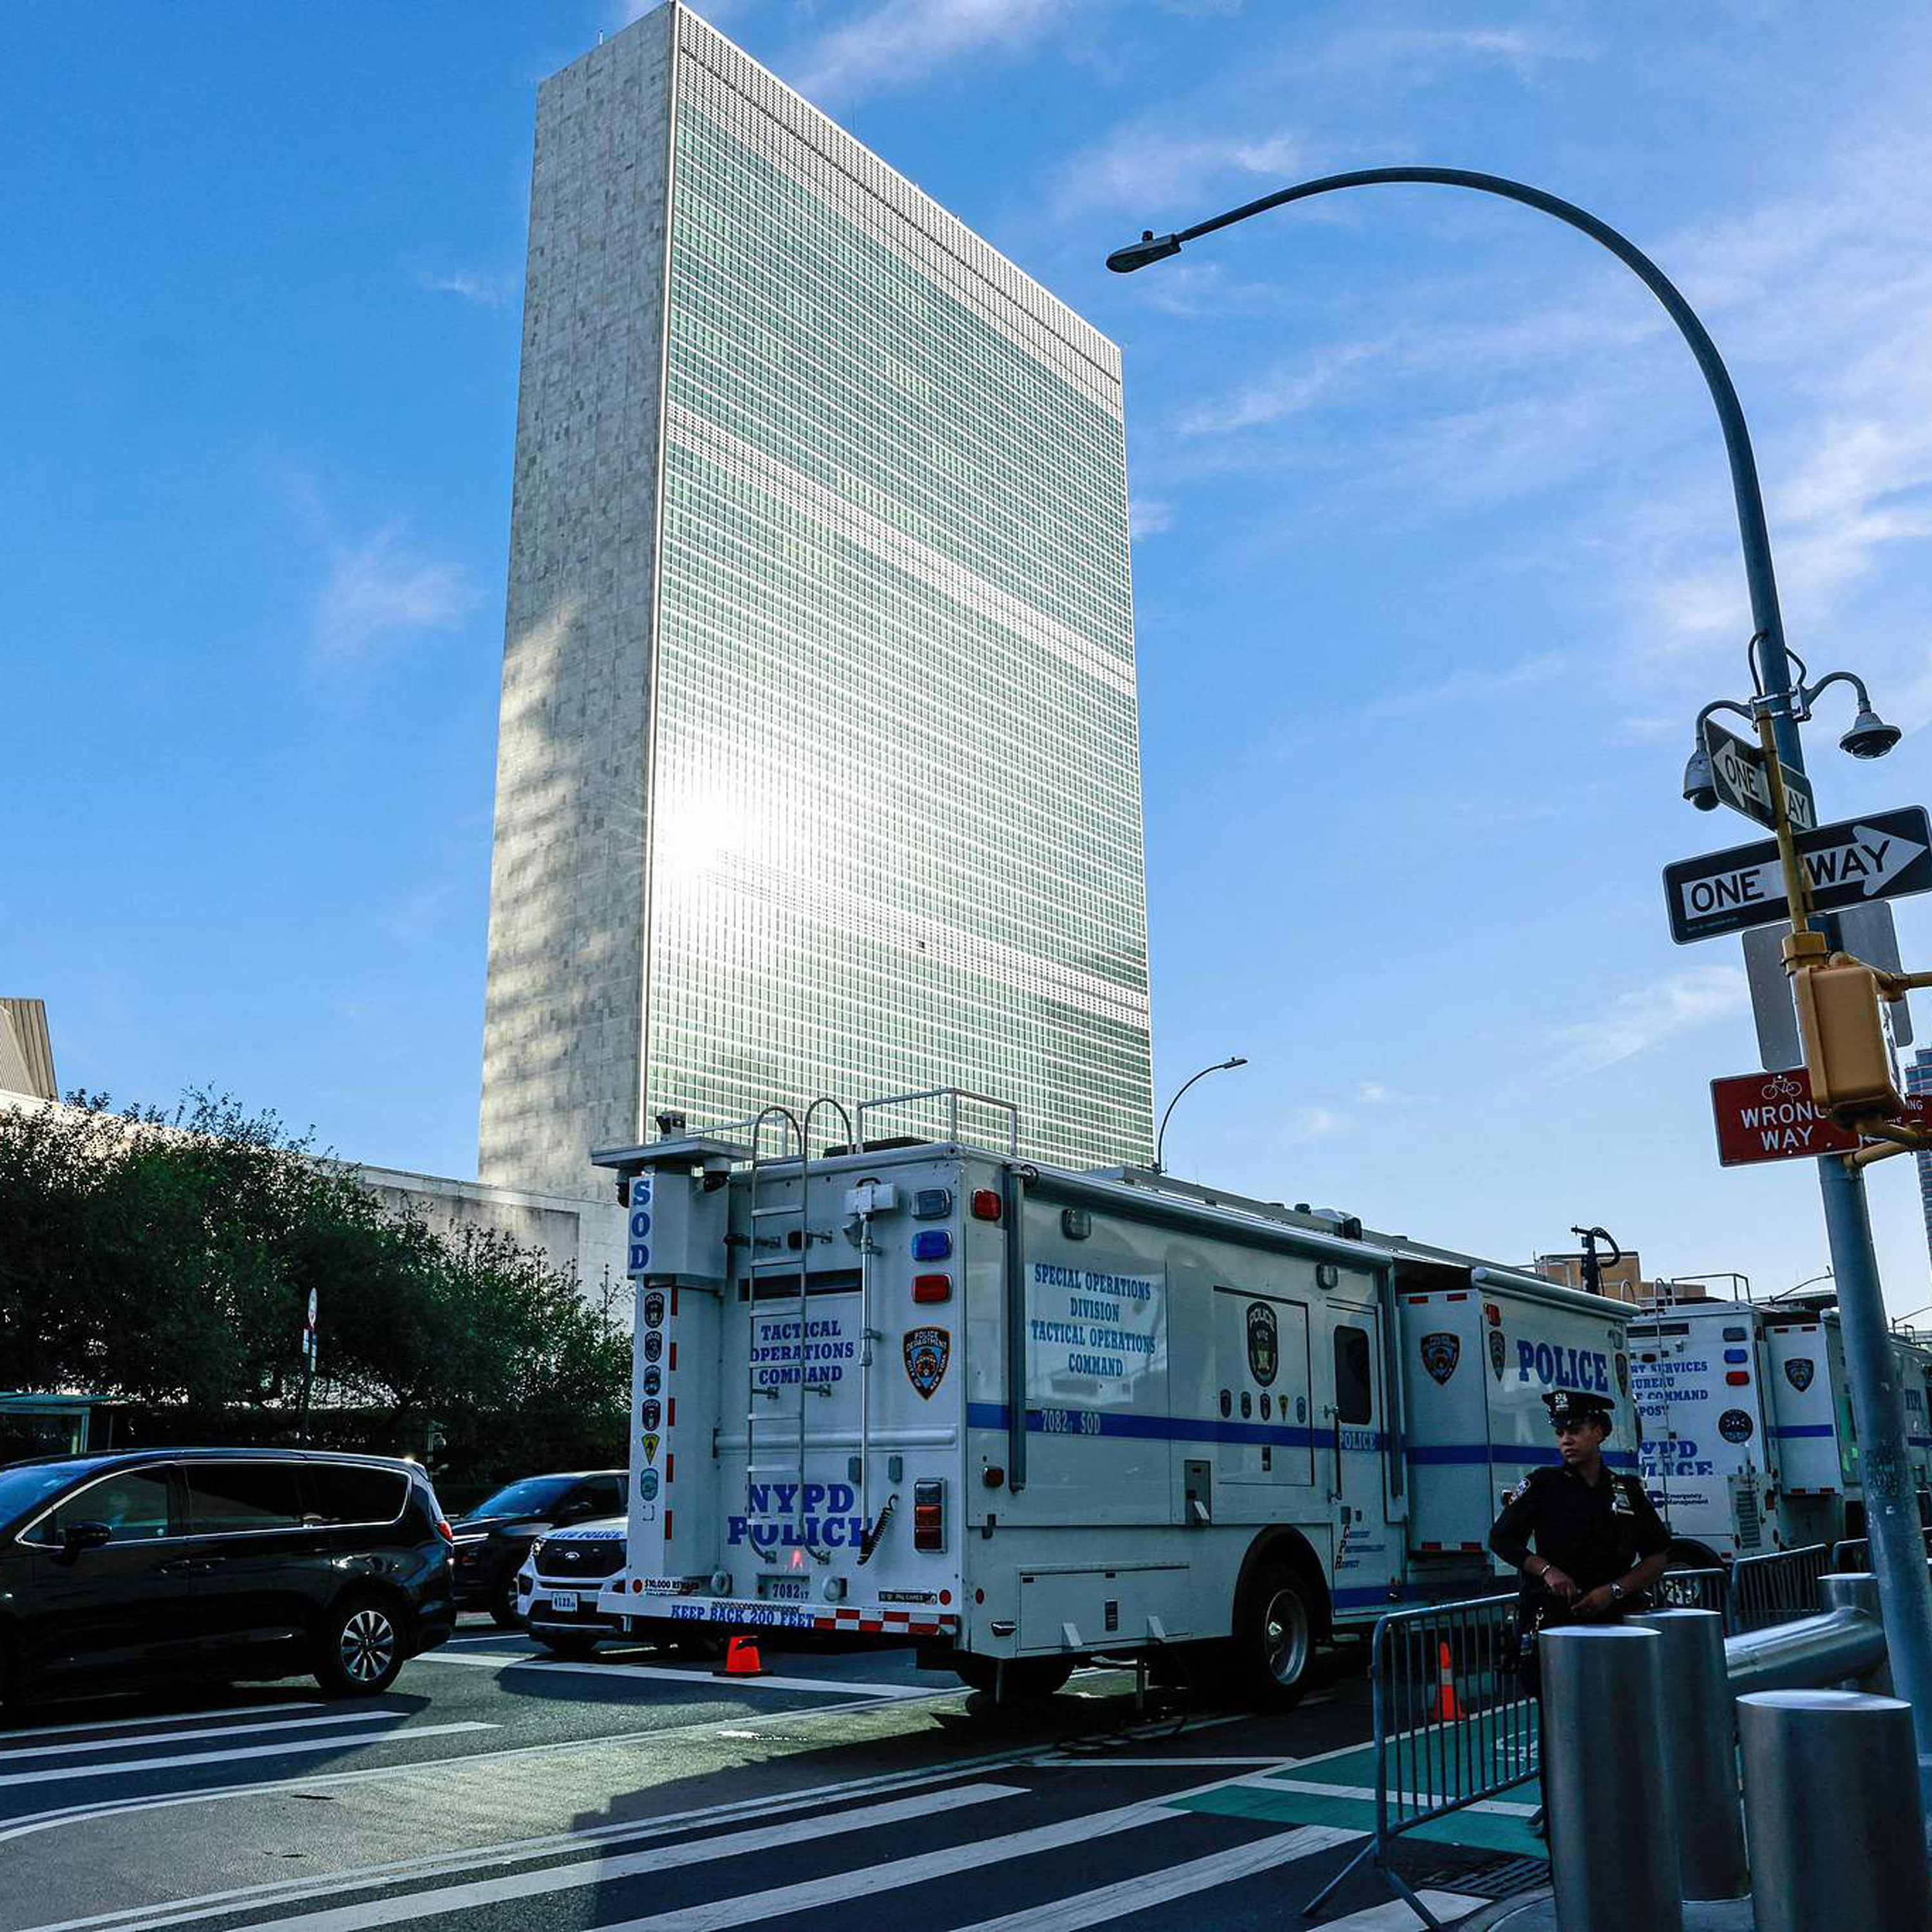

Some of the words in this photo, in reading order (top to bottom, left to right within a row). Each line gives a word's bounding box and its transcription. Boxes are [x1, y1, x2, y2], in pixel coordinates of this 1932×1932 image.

[1725, 755, 1759, 797] ONE
[1786, 790, 1805, 823] AY
[1691, 869, 1765, 912] ONE
[1805, 840, 1890, 886] WAY
[1761, 1125, 1814, 1151] WAY
[630, 1180, 650, 1269] SOD
[1035, 1264, 1081, 1289] SPECIAL
[1085, 1272, 1151, 1301] OPERATIONS
[1070, 1298, 1120, 1322] DIVISION
[761, 1320, 841, 1341] TACTICAL
[1031, 1320, 1085, 1345] TACTICAL
[1090, 1329, 1156, 1354] OPERATIONS
[750, 1341, 854, 1362] OPERATIONS
[759, 1366, 842, 1385] COMMAND
[1069, 1354, 1123, 1377] COMMAND
[1517, 1340, 1609, 1392] POLICE
[1647, 1390, 1708, 1401] COMMAND
[1081, 1412, 1101, 1434] SOD
[1340, 1432, 1376, 1449] POLICE
[1642, 1441, 1698, 1458] YPD
[1647, 1461, 1713, 1476] LICE
[749, 1484, 855, 1513] NYPD
[773, 1584, 800, 1598] 7082
[671, 1605, 705, 1620] KEEP
[710, 1608, 745, 1624] BACK
[750, 1610, 774, 1625] 200
[781, 1612, 815, 1628] FEET
